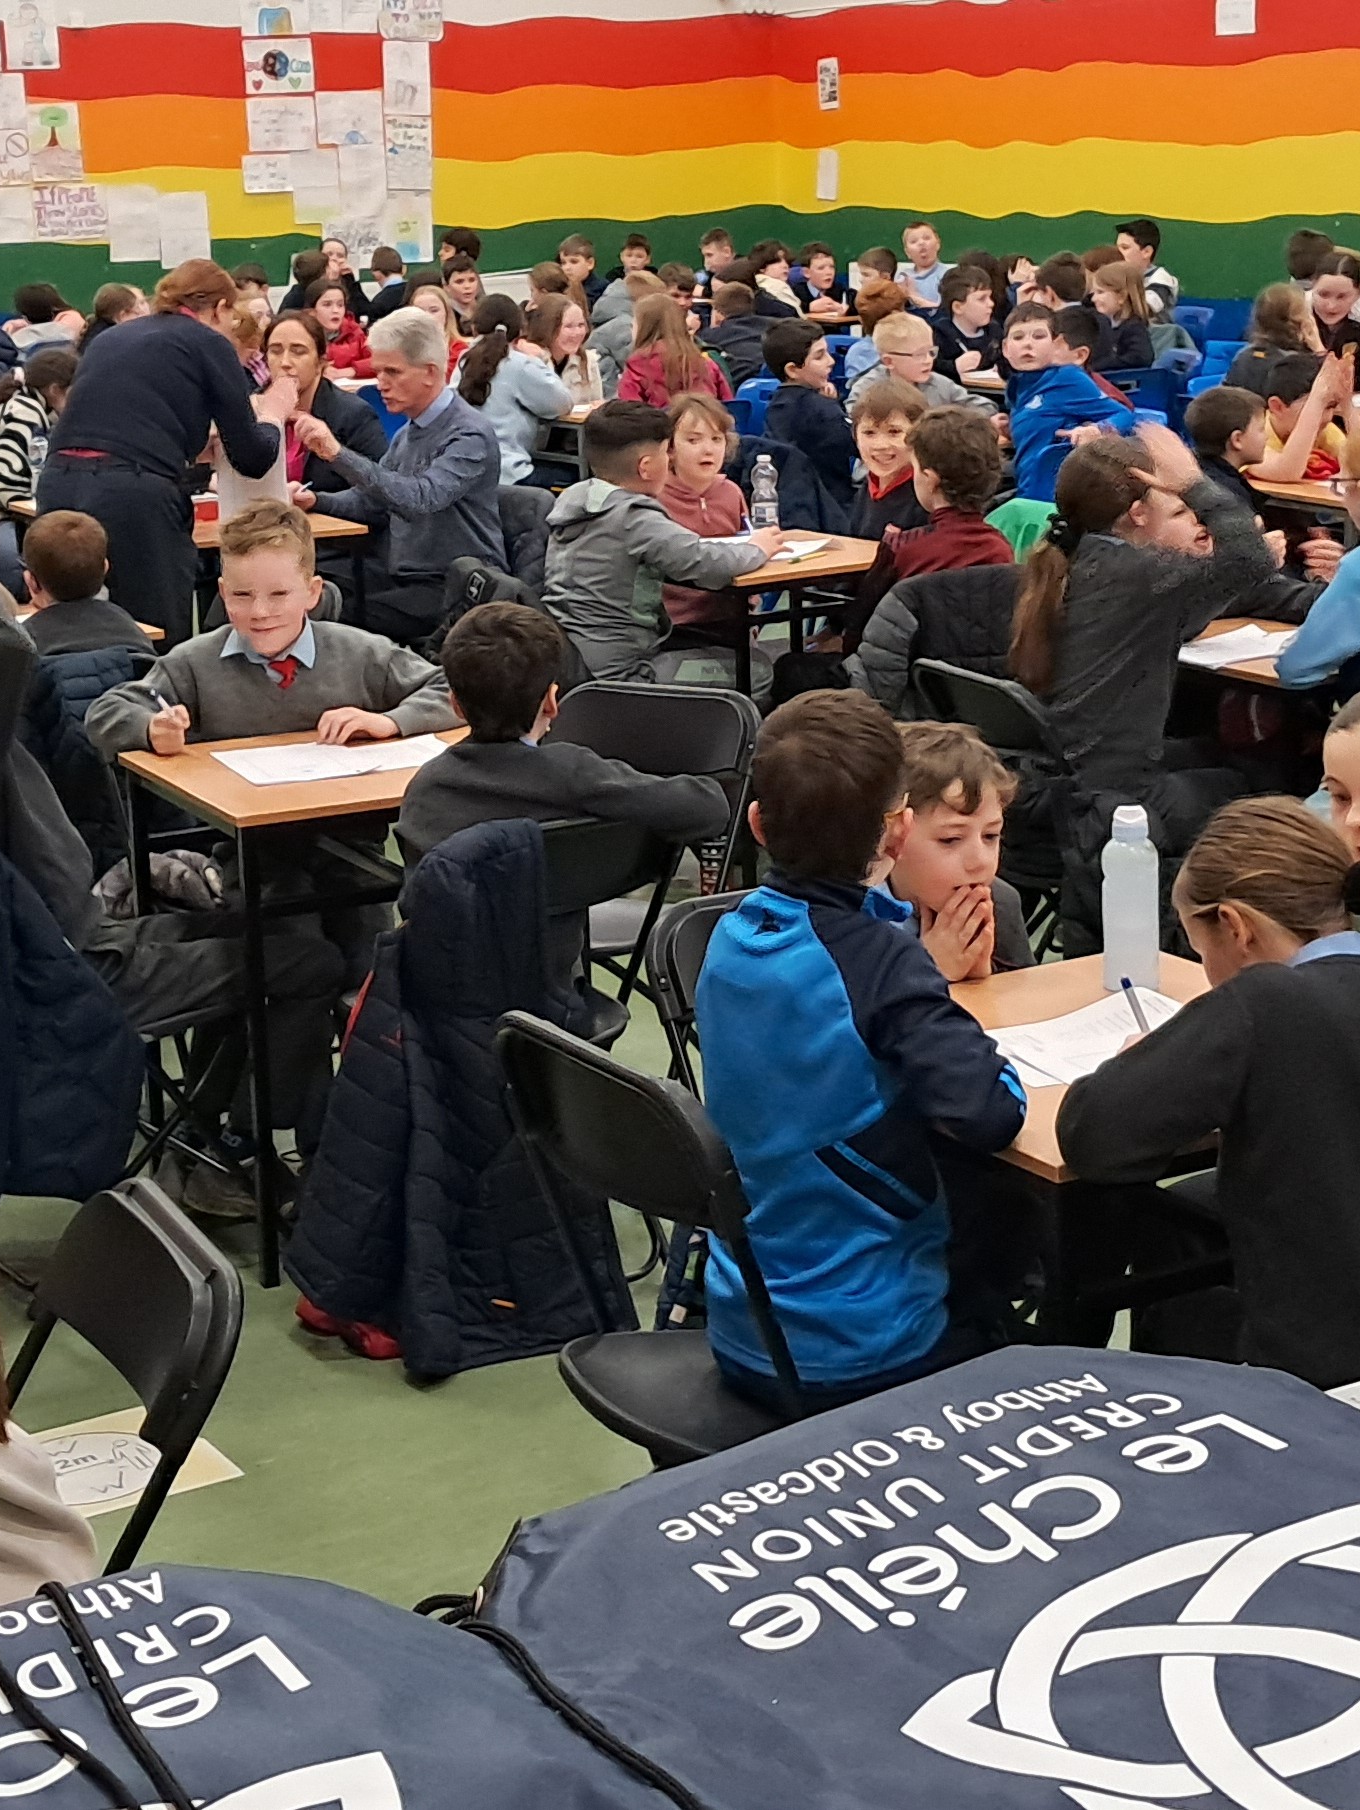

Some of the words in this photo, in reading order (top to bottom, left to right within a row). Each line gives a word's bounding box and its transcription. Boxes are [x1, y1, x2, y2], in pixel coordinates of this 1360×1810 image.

[892, 1425, 946, 1451] &
[942, 1372, 1109, 1434] Athboy
[958, 1392, 1184, 1485] CREDIT
[55, 1454, 98, 1470] 2m
[1120, 1411, 1290, 1475] Le
[657, 1439, 900, 1542] Oldcastle
[690, 1476, 946, 1593] UNION
[120, 1634, 312, 1730] Le
